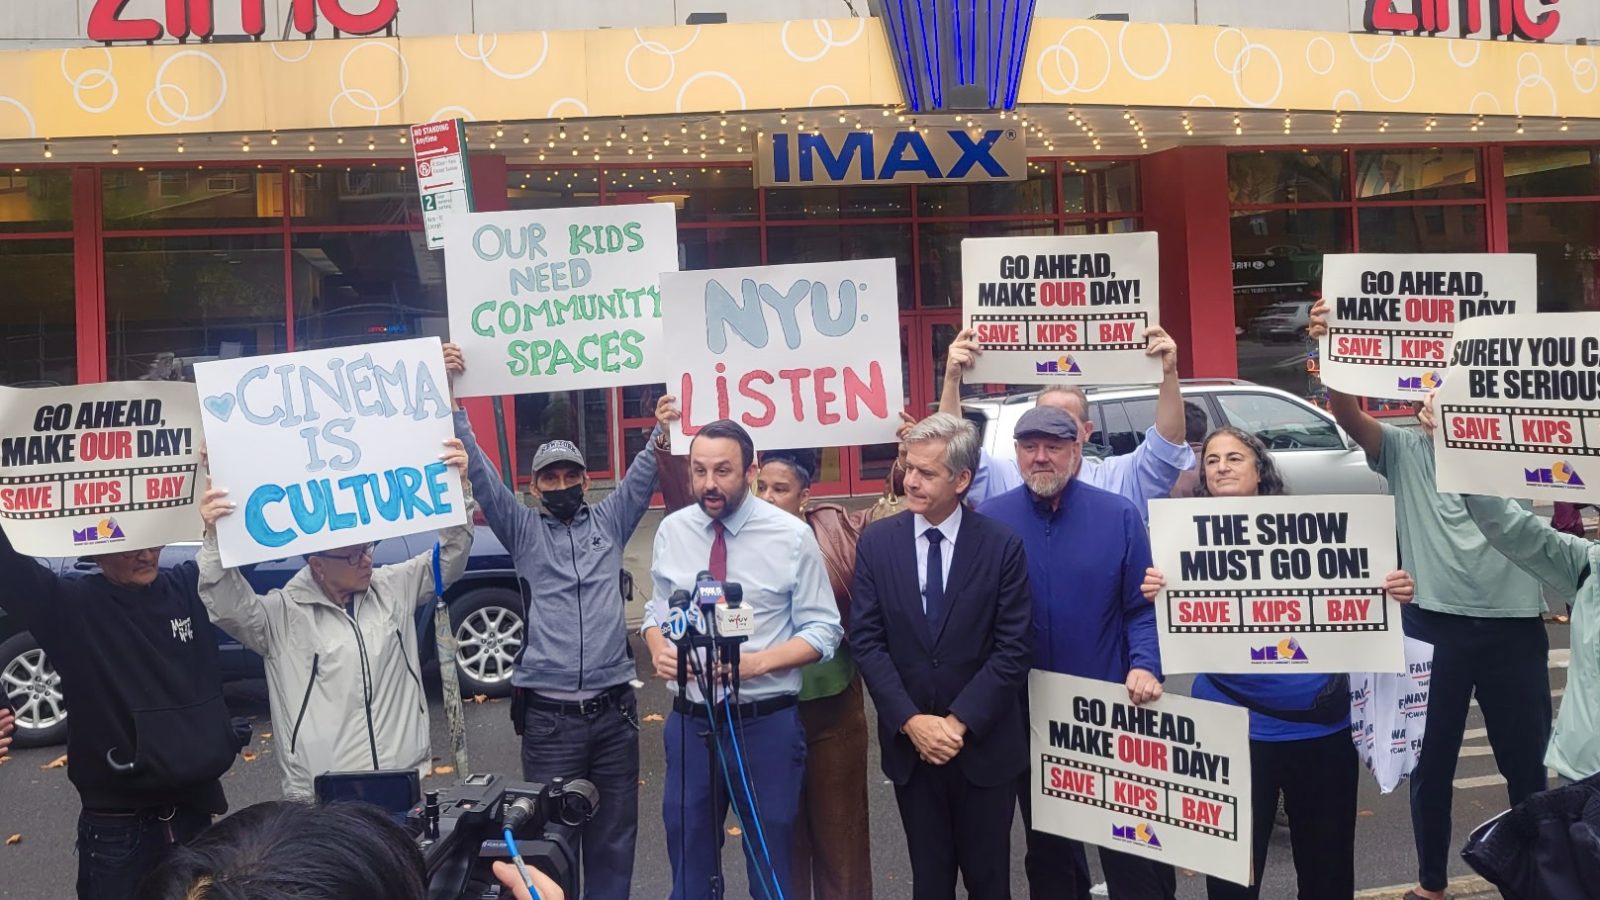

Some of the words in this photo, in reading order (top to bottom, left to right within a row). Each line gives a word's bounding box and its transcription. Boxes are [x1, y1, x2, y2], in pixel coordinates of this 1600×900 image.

[414, 128, 423, 137] NO
[423, 123, 450, 136] STANDING
[425, 195, 434, 210] 2
[471, 223, 548, 262] OUR
[569, 222, 645, 255] KIDS
[509, 258, 592, 296] NEED
[1000, 255, 1030, 280] GO
[1033, 253, 1116, 280] AHEAD,
[978, 281, 1036, 307] MAKE
[1040, 281, 1087, 307] OUR
[1090, 279, 1141, 306] DAY!
[1361, 271, 1394, 296] GO
[1398, 271, 1489, 299] AHEAD,
[471, 285, 662, 338] COMMUNITY
[704, 278, 869, 354] NYU:
[1336, 297, 1401, 322] MAKE
[1405, 298, 1455, 323] OUR
[978, 324, 1019, 343] SAVE
[1036, 323, 1078, 343] KIPS
[1099, 322, 1136, 343] BAY
[1338, 336, 1382, 357] SAVE
[1401, 339, 1444, 360] KIPS
[506, 329, 645, 376] SPACES
[1450, 337, 1523, 367] SURELY
[1527, 336, 1576, 367] YOU
[1581, 336, 1600, 368] C
[236, 351, 451, 428] CINEMA
[1469, 369, 1500, 398] BE
[34, 405, 74, 432] GO
[75, 398, 166, 430] AHEAD,
[1452, 416, 1502, 441] SAVE
[1522, 419, 1573, 444] KIPS
[1, 434, 76, 467] MAKE
[79, 431, 133, 462] OUR
[137, 428, 192, 458] DAY!
[300, 417, 362, 472] IS
[541, 441, 557, 455] NEW
[559, 441, 577, 454] YORK
[1, 486, 52, 511] SAVE
[74, 480, 121, 506] KIPS
[146, 475, 185, 500] BAY
[245, 462, 453, 548] CULTURE
[1193, 514, 1250, 546] THE
[1256, 512, 1348, 545] SHOW
[1180, 549, 1264, 581] MUST
[1270, 548, 1312, 580] GO
[1317, 547, 1370, 579] ON!
[1179, 601, 1230, 623] SAVE
[1252, 600, 1302, 622] KIPS
[1327, 599, 1371, 622] BAY
[1073, 696, 1107, 727] GO
[1111, 702, 1201, 749] AHEAD,
[1049, 720, 1114, 759] MAKE
[1118, 734, 1168, 772] OUR
[1173, 745, 1230, 785] DAY!
[1051, 766, 1095, 796] SAVE
[1114, 780, 1158, 811] KIPS
[1182, 797, 1223, 827] BAY
